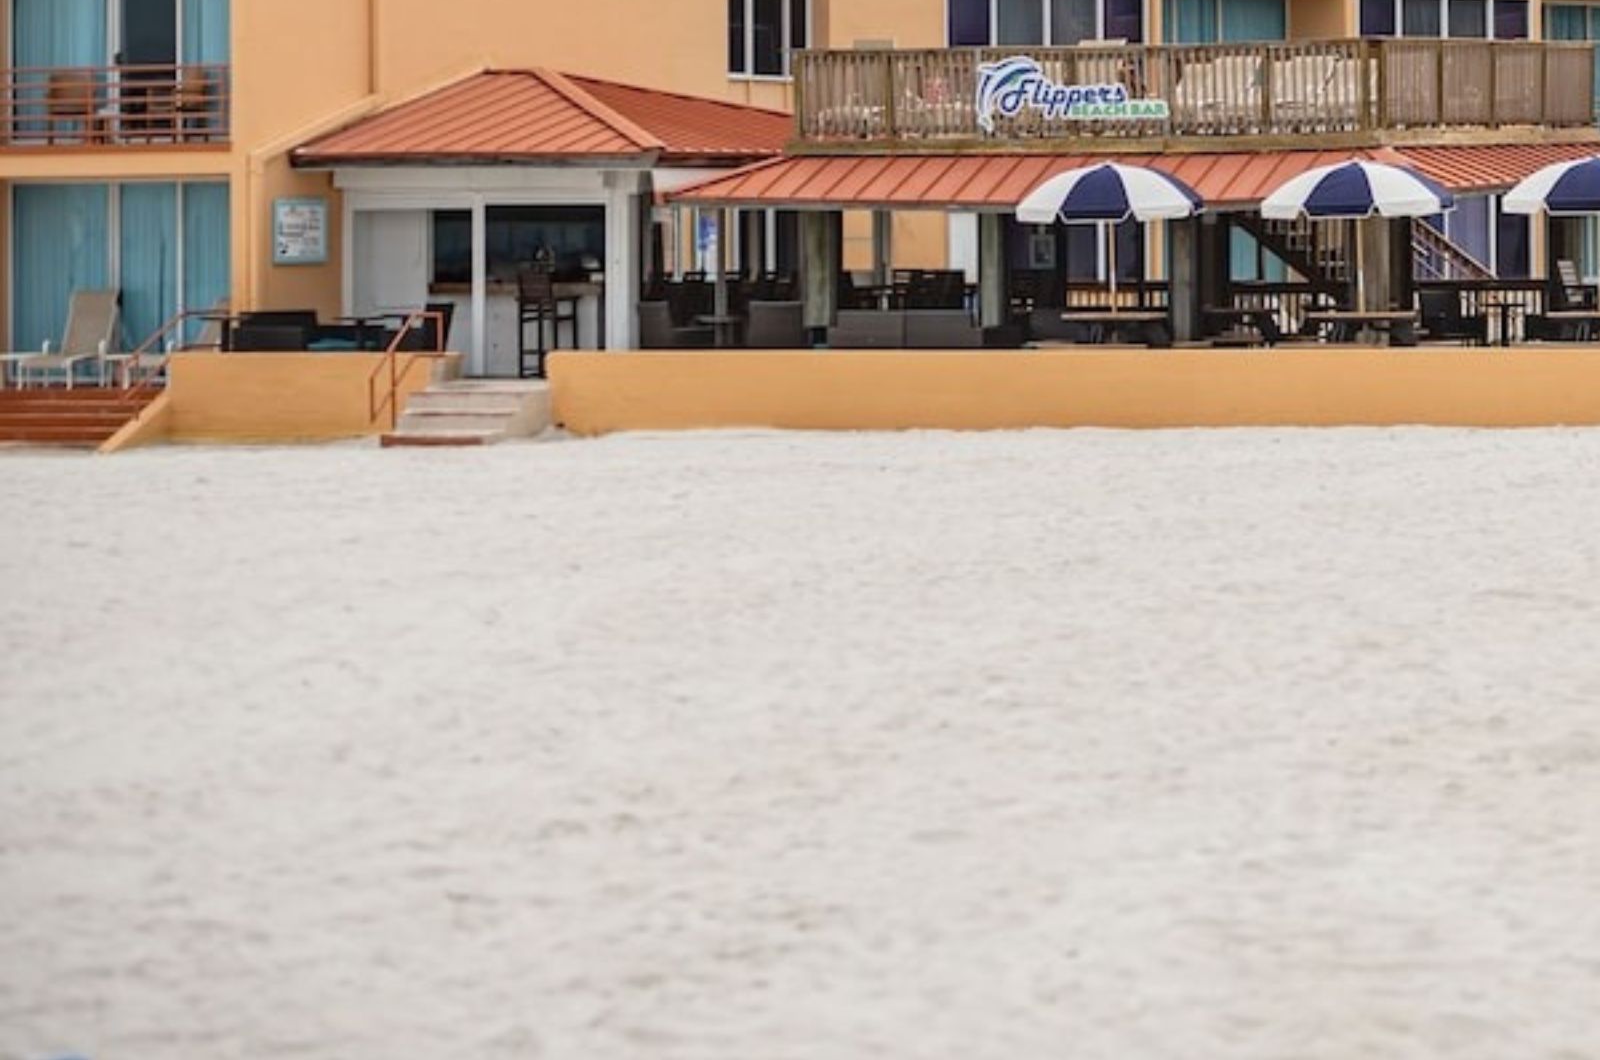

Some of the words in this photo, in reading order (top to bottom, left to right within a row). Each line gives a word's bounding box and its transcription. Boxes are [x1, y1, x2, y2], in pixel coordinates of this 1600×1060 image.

[1001, 78, 1126, 115] Flippers
[1071, 103, 1128, 116] BEACH
[1130, 103, 1165, 116] BAR
